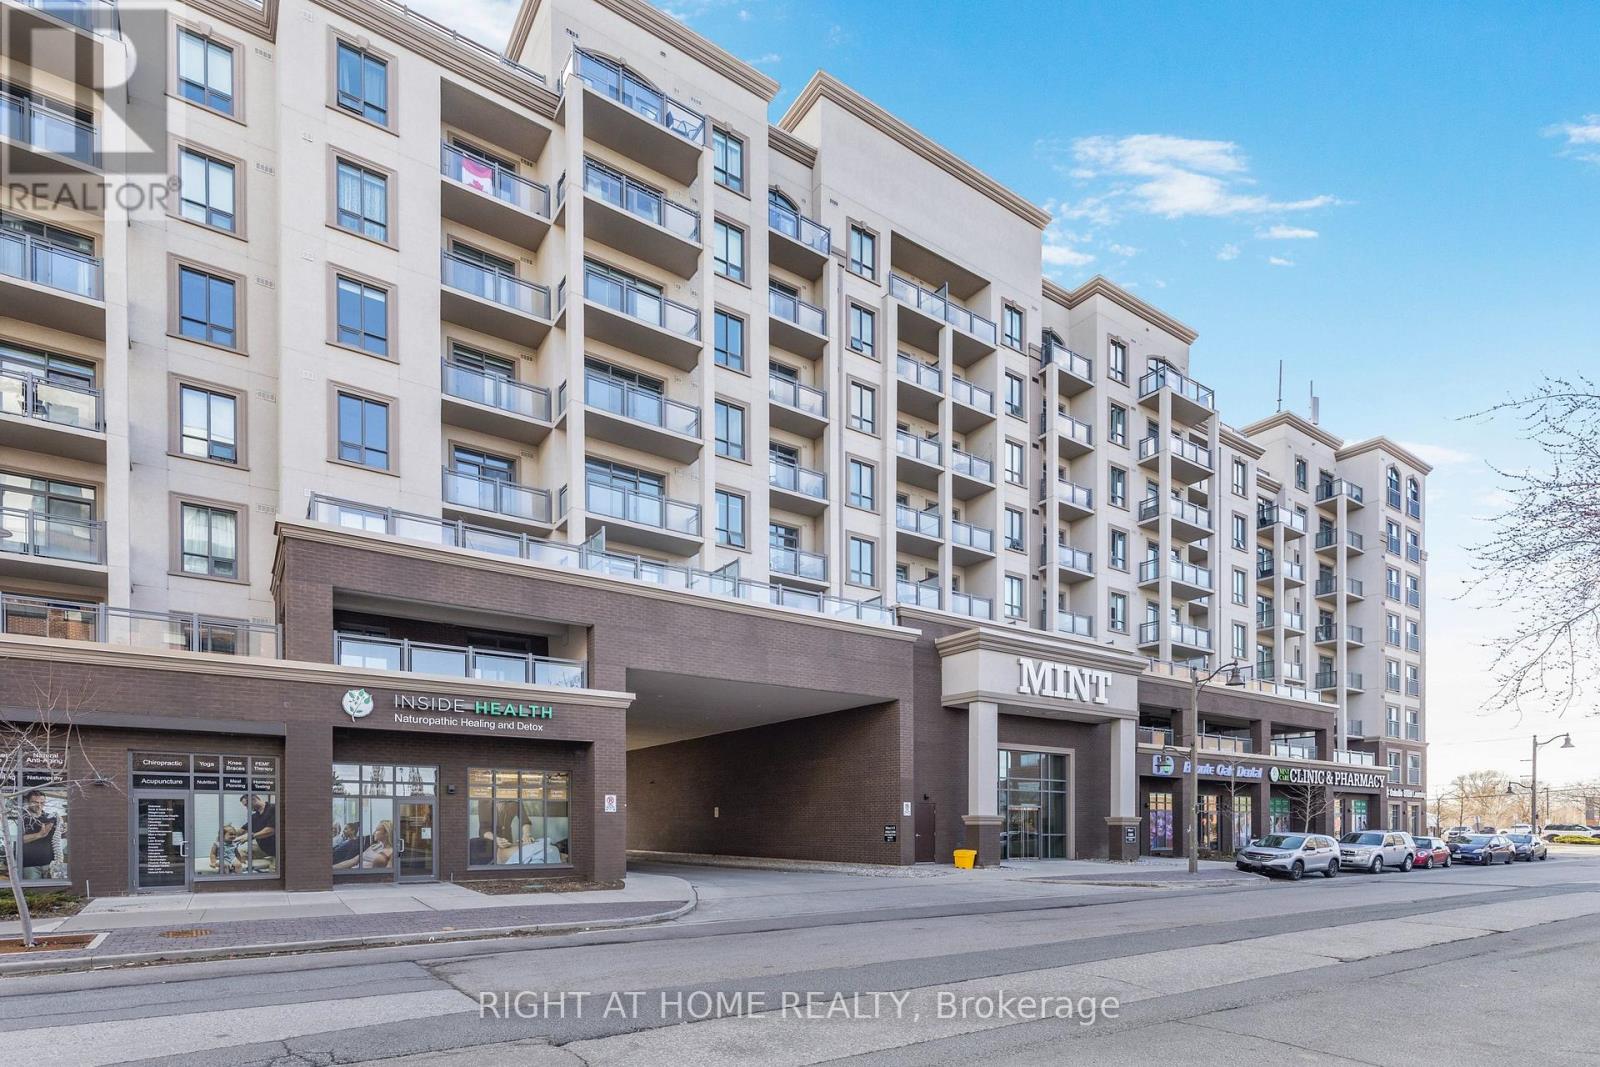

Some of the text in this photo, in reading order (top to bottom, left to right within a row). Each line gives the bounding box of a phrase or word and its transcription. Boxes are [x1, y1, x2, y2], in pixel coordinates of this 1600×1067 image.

[1018, 657, 1112, 704] MINT
[394, 694, 553, 719] INSIDE HEALTH
[394, 713, 544, 732] Naturopathic Healing and Detox
[142, 758, 183, 768] Chiropractic
[141, 778, 183, 786] Acupuncture
[1289, 768, 1386, 788] CLINIC & PHARMACY
